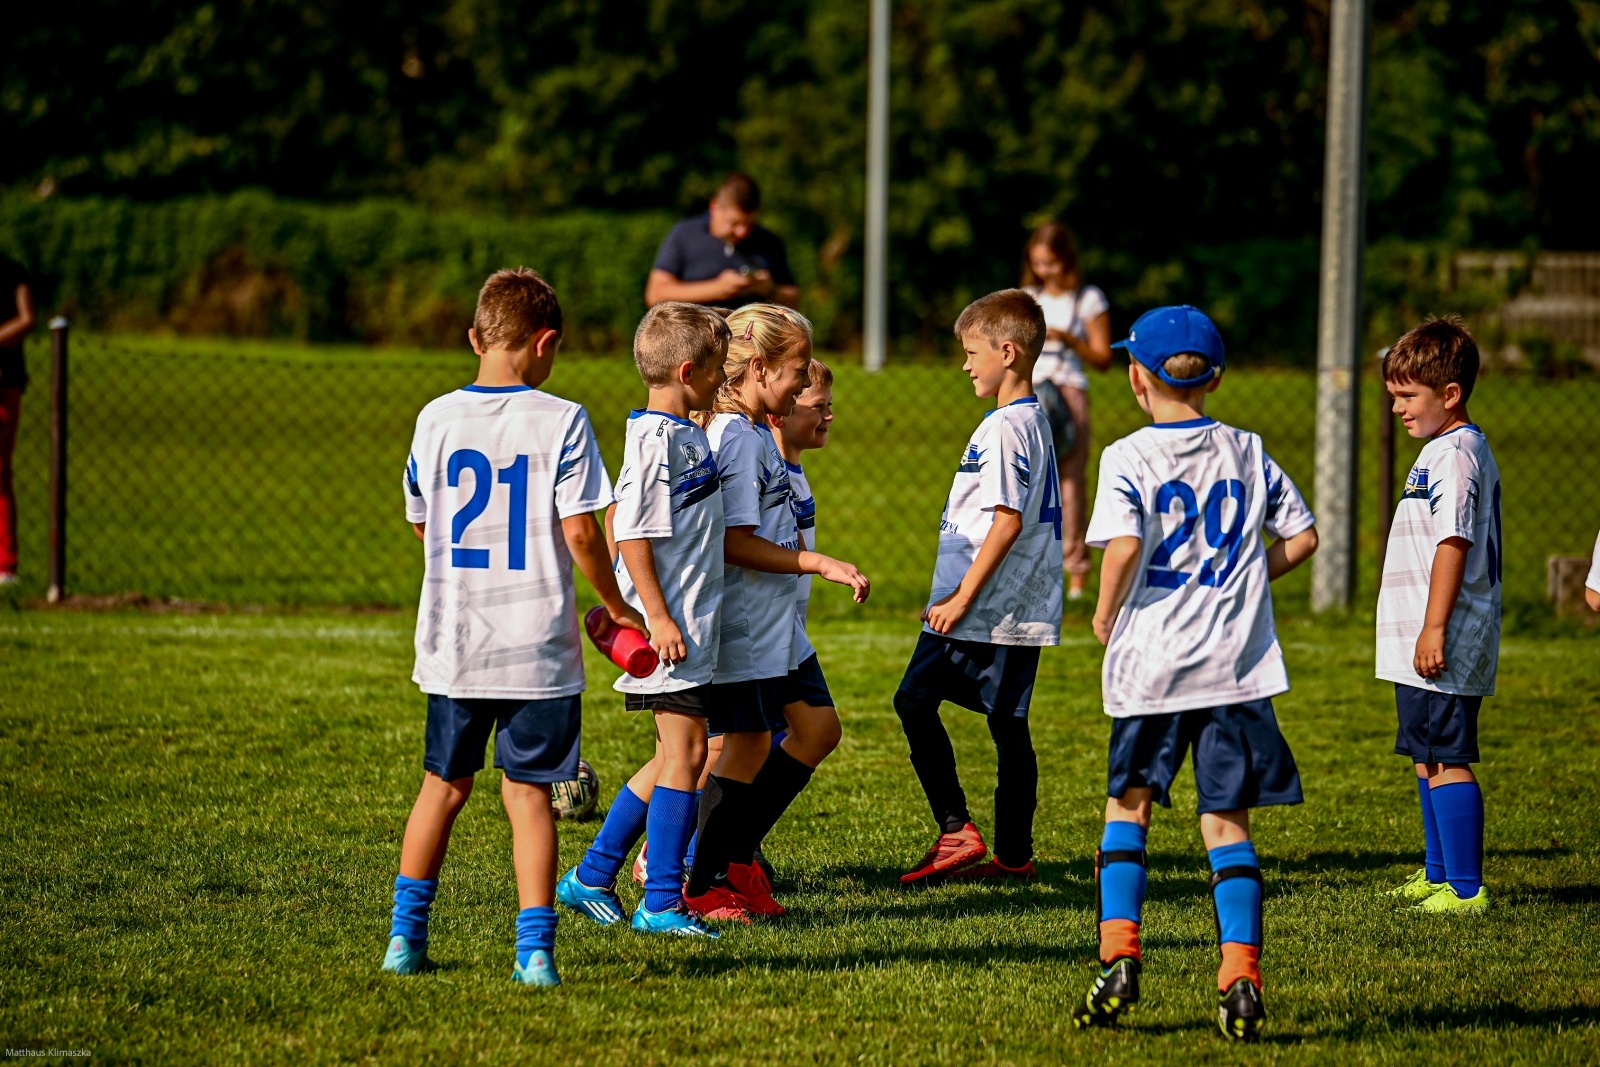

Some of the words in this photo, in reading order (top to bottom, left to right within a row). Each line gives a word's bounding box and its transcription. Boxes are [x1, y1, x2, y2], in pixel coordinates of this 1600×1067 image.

[447, 448, 528, 570] 21
[1146, 479, 1246, 588] 29
[1011, 567, 1051, 600] AKADEMIA
